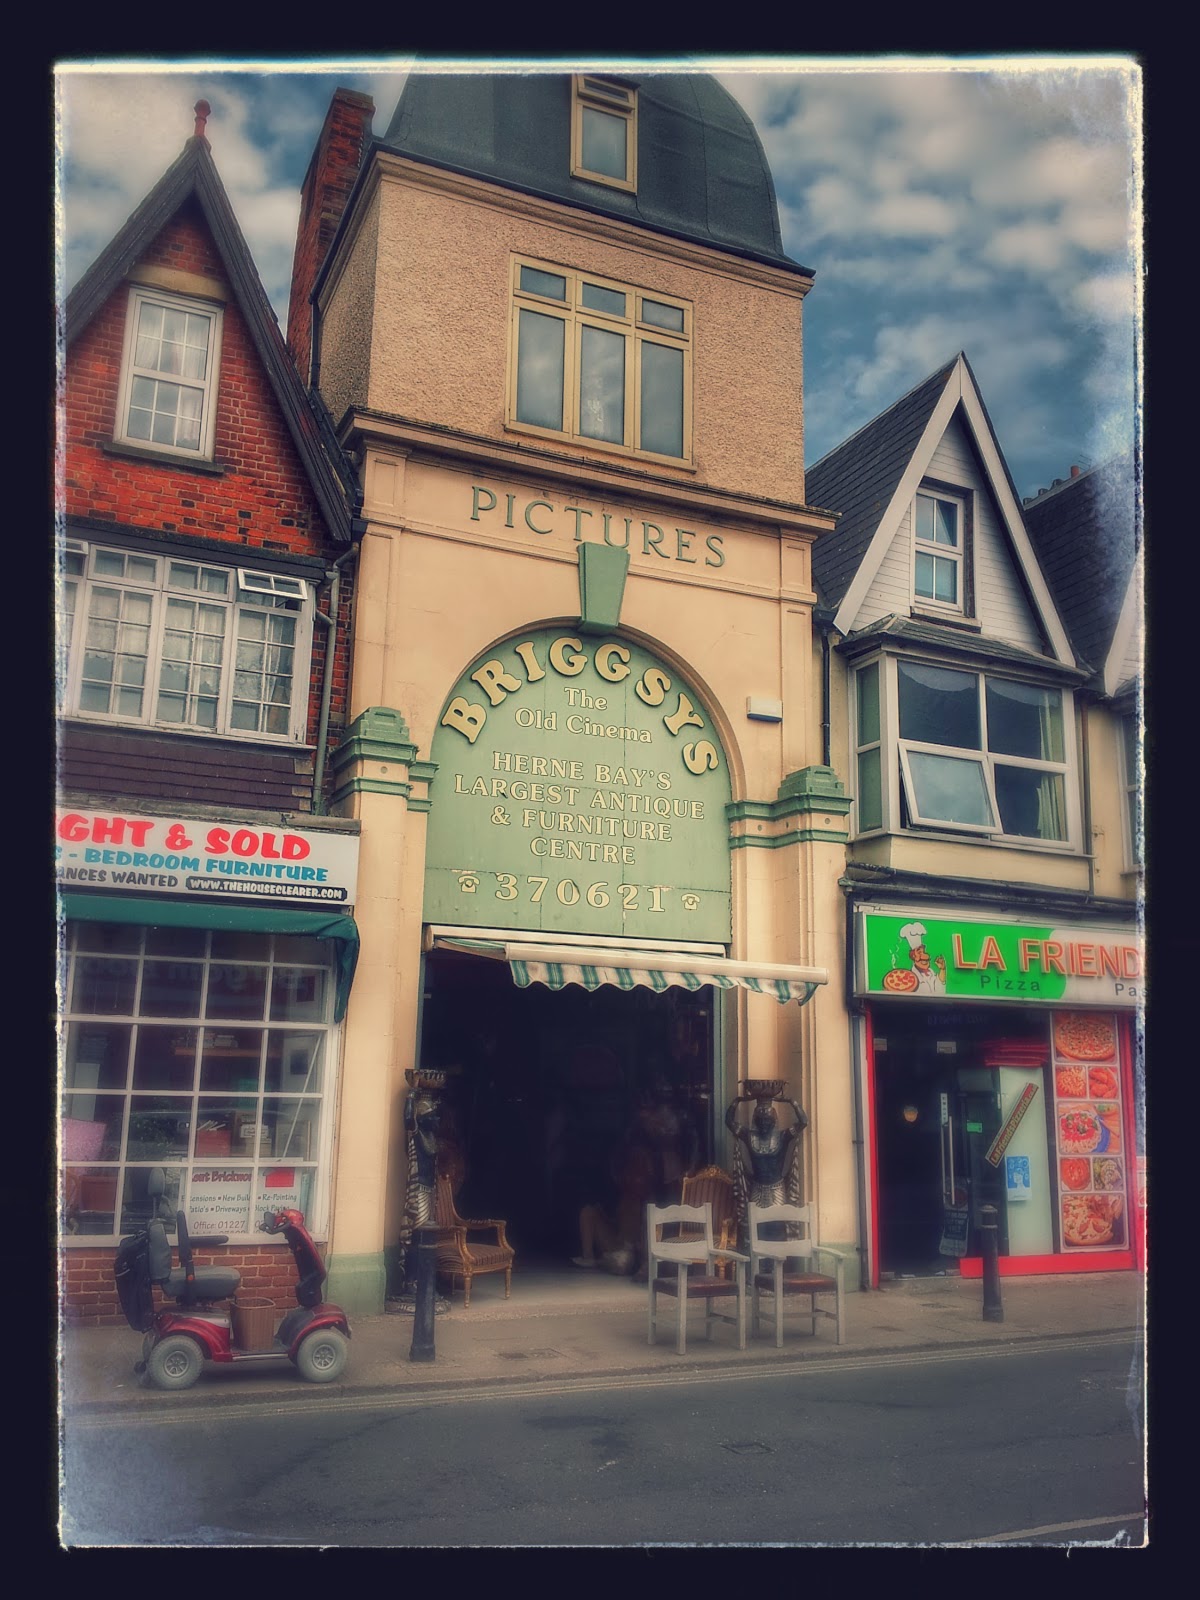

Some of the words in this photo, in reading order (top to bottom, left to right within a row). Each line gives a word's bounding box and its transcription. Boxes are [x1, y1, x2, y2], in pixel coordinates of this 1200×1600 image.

[470, 486, 725, 567] PICTURES
[442, 637, 719, 775] BRIGGSYS
[564, 687, 608, 710] The
[515, 708, 557, 731] Old
[566, 715, 652, 743] Cinema
[493, 751, 584, 780] HERNE
[595, 764, 672, 790] BAY'S
[455, 774, 580, 806] LARGEST
[590, 790, 705, 820] ANTIQUE
[165, 823, 193, 850] &
[204, 828, 311, 860] SOLD
[491, 806, 511, 825] &
[523, 809, 672, 842] FURNITURE
[84, 848, 200, 872] BEDROOM
[206, 858, 329, 882] FURNITURE
[530, 837, 636, 865] CENTRE
[111, 871, 178, 888] WANTED
[190, 878, 343, 899] WWW.THEHOUSECLEARER.COM
[495, 872, 665, 912] 370621
[953, 933, 1007, 971] LA
[980, 975, 1041, 992] Pizza
[215, 1205, 247, 1214] Driveways
[263, 1194, 297, 1202] Re-Pointing
[194, 1221, 216, 1230] Office:
[218, 1221, 246, 1230] 01227
